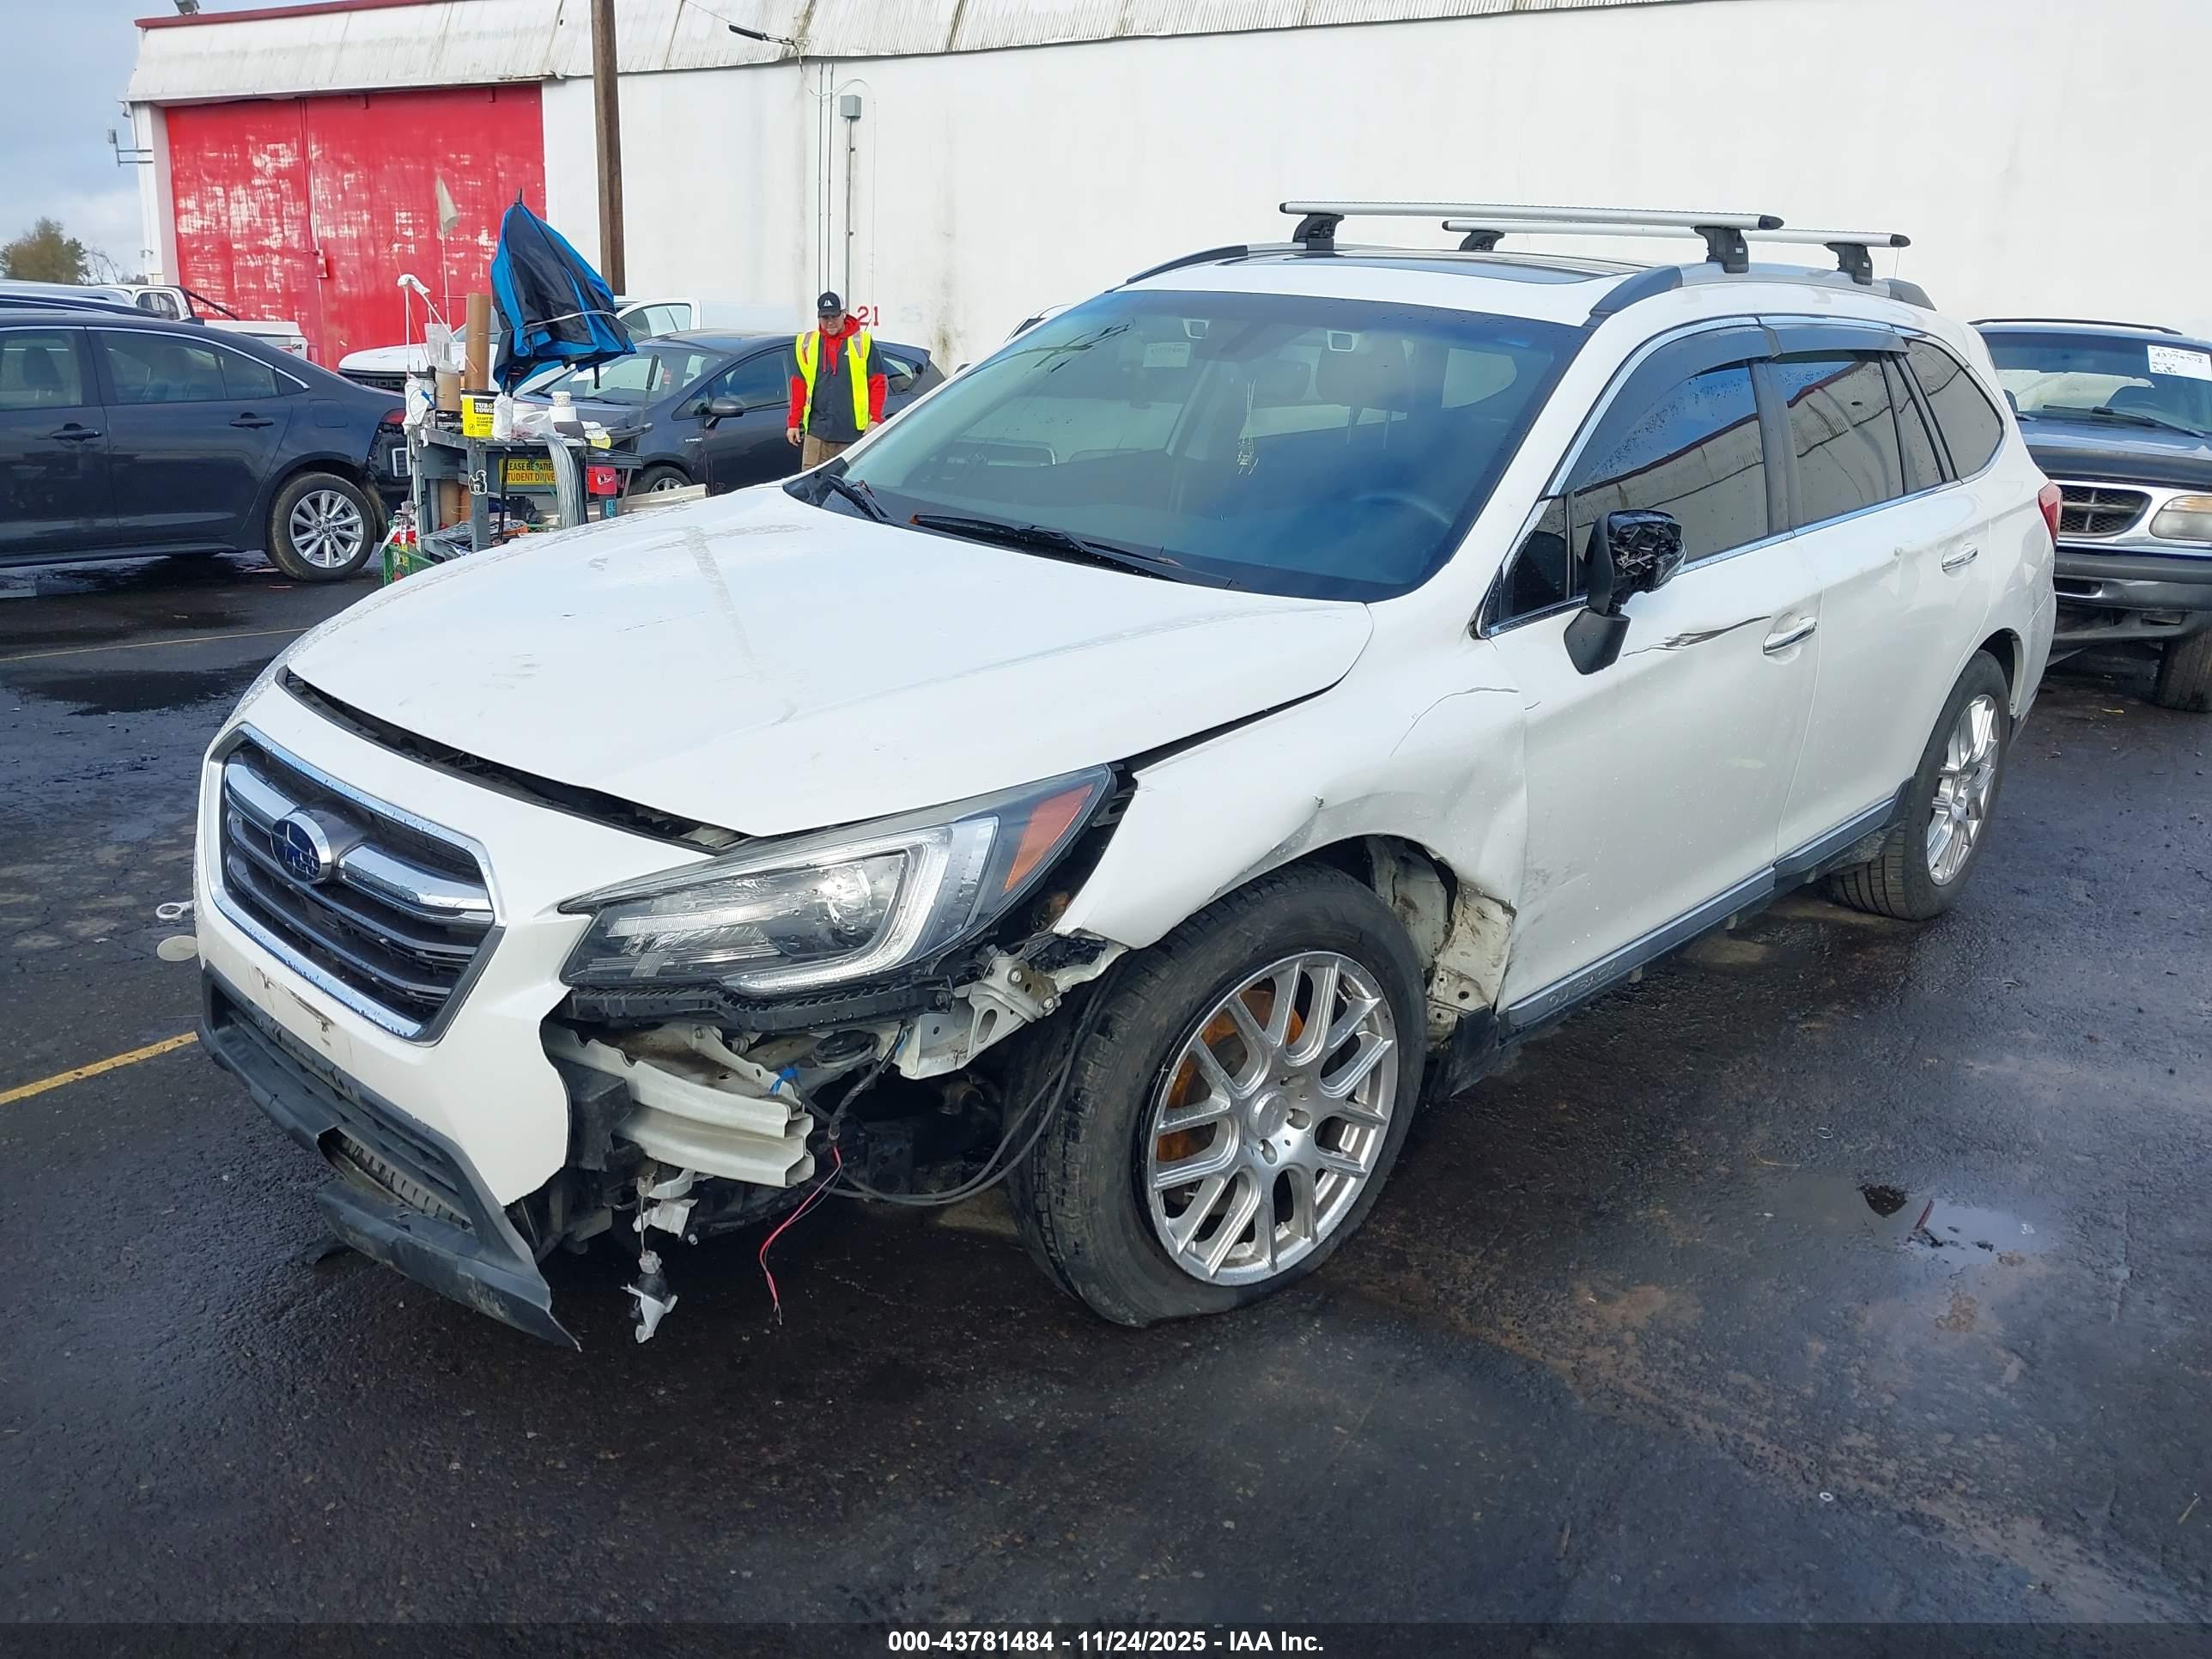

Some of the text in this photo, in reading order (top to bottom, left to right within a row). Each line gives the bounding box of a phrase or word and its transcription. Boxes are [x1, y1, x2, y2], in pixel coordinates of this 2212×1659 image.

[857, 305, 879, 326] 21
[507, 472, 556, 481] TUDENT DIVE
